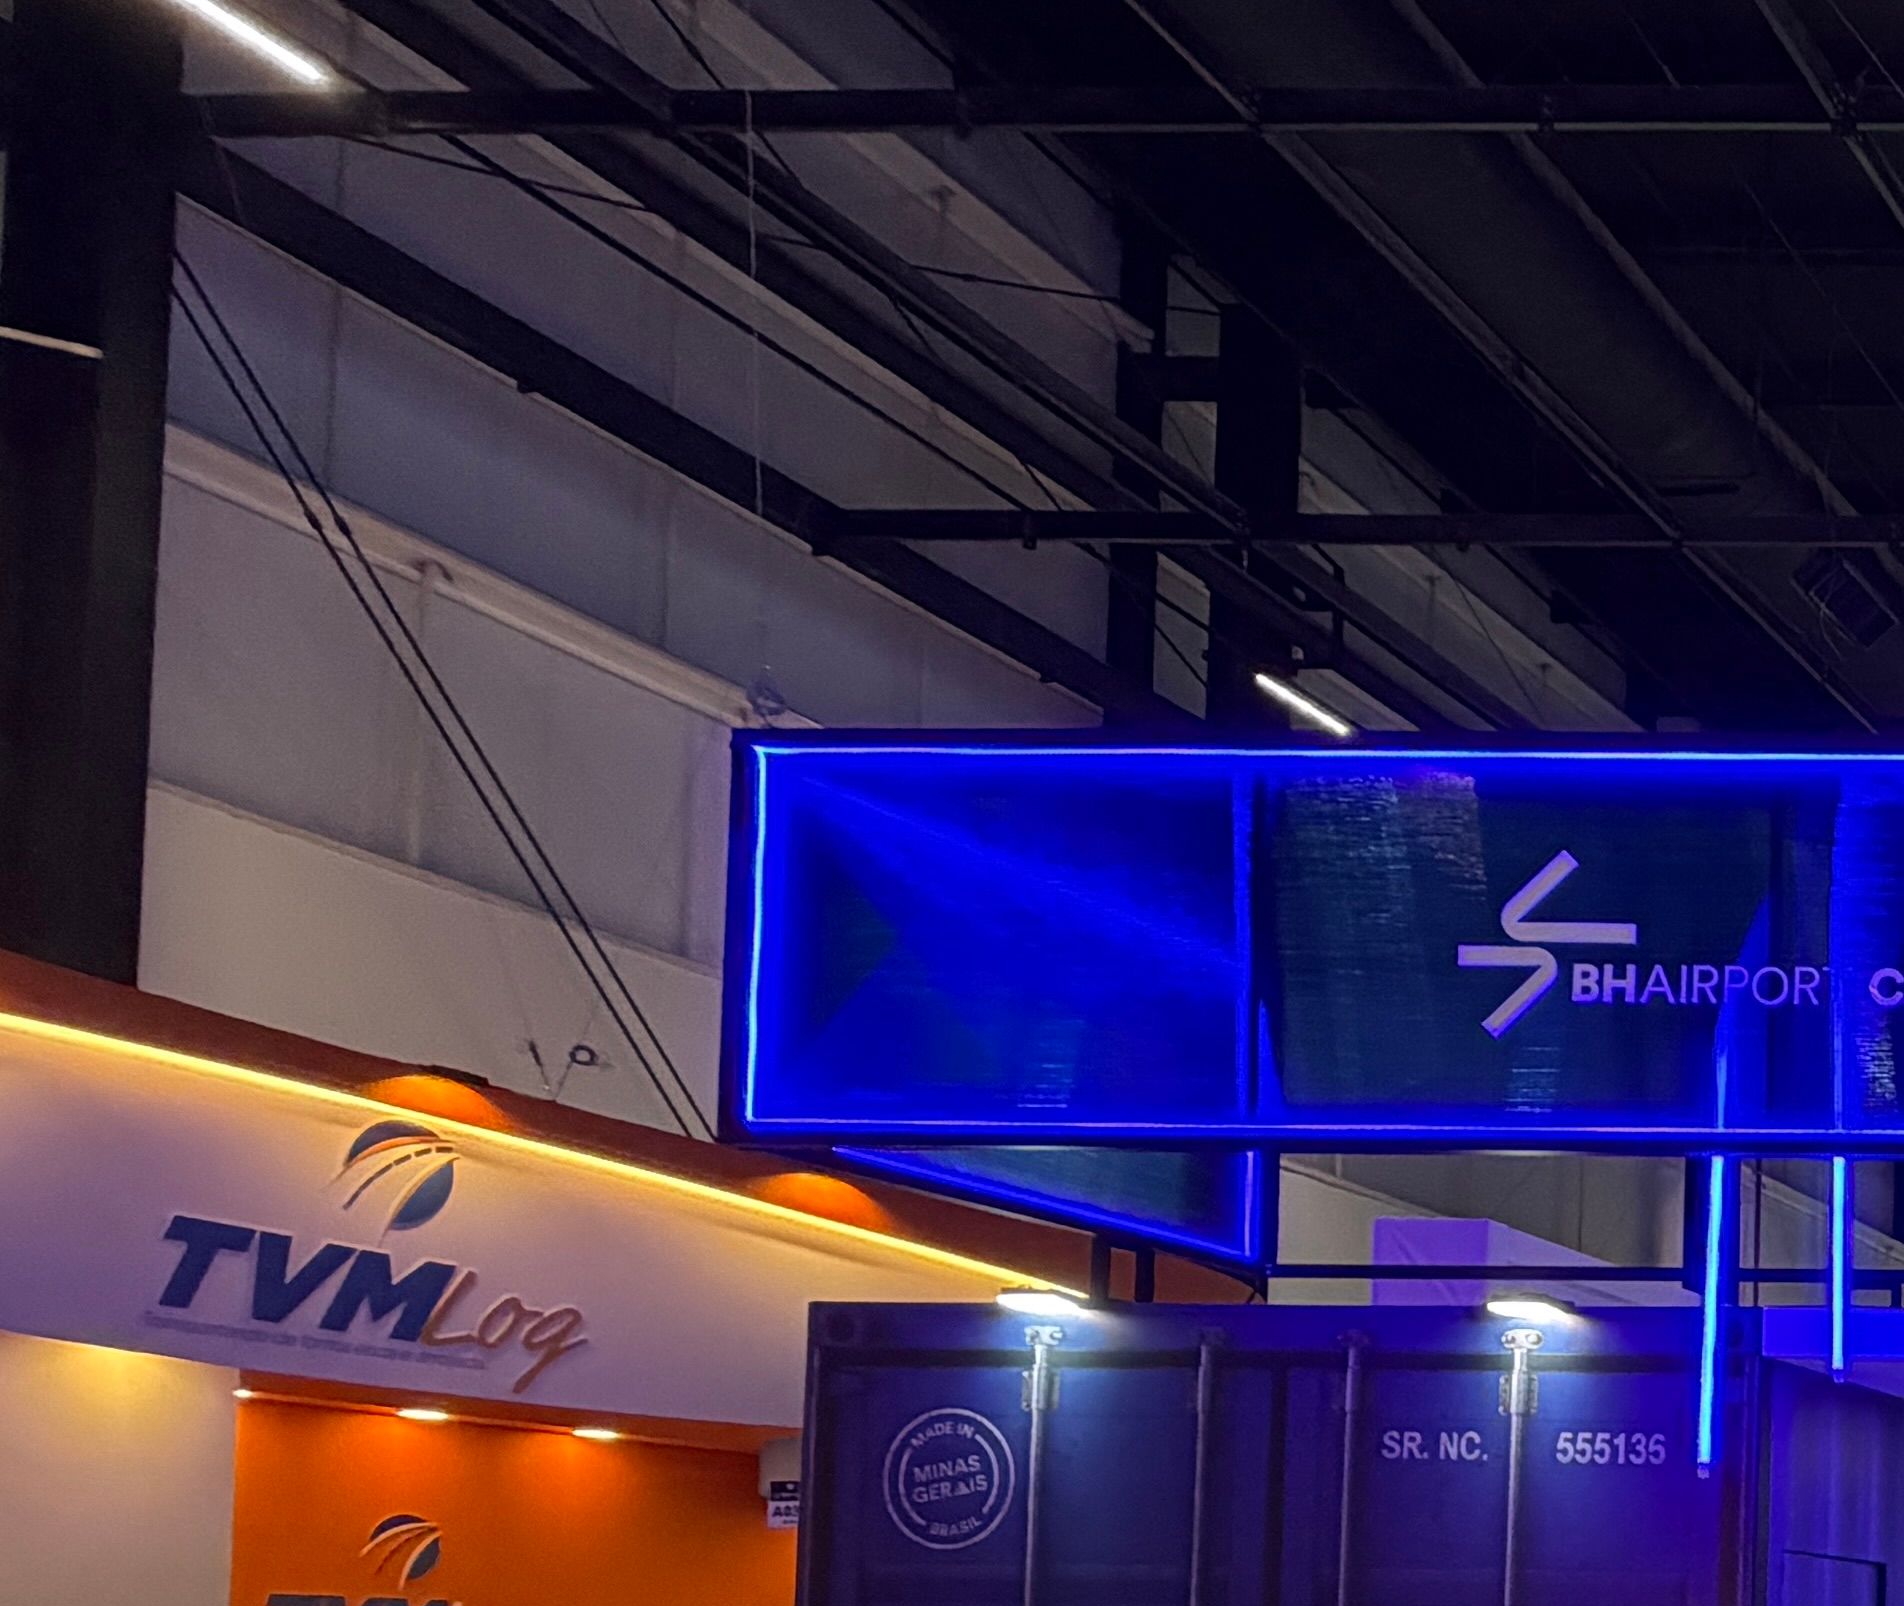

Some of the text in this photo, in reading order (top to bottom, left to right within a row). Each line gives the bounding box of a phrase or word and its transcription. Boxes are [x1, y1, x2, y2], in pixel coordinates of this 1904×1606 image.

[1380, 1430, 1430, 1461] SR.
[912, 1454, 981, 1483] MINAS
[911, 1473, 989, 1503] GERAIS
[928, 1516, 983, 1538] BRASIL
